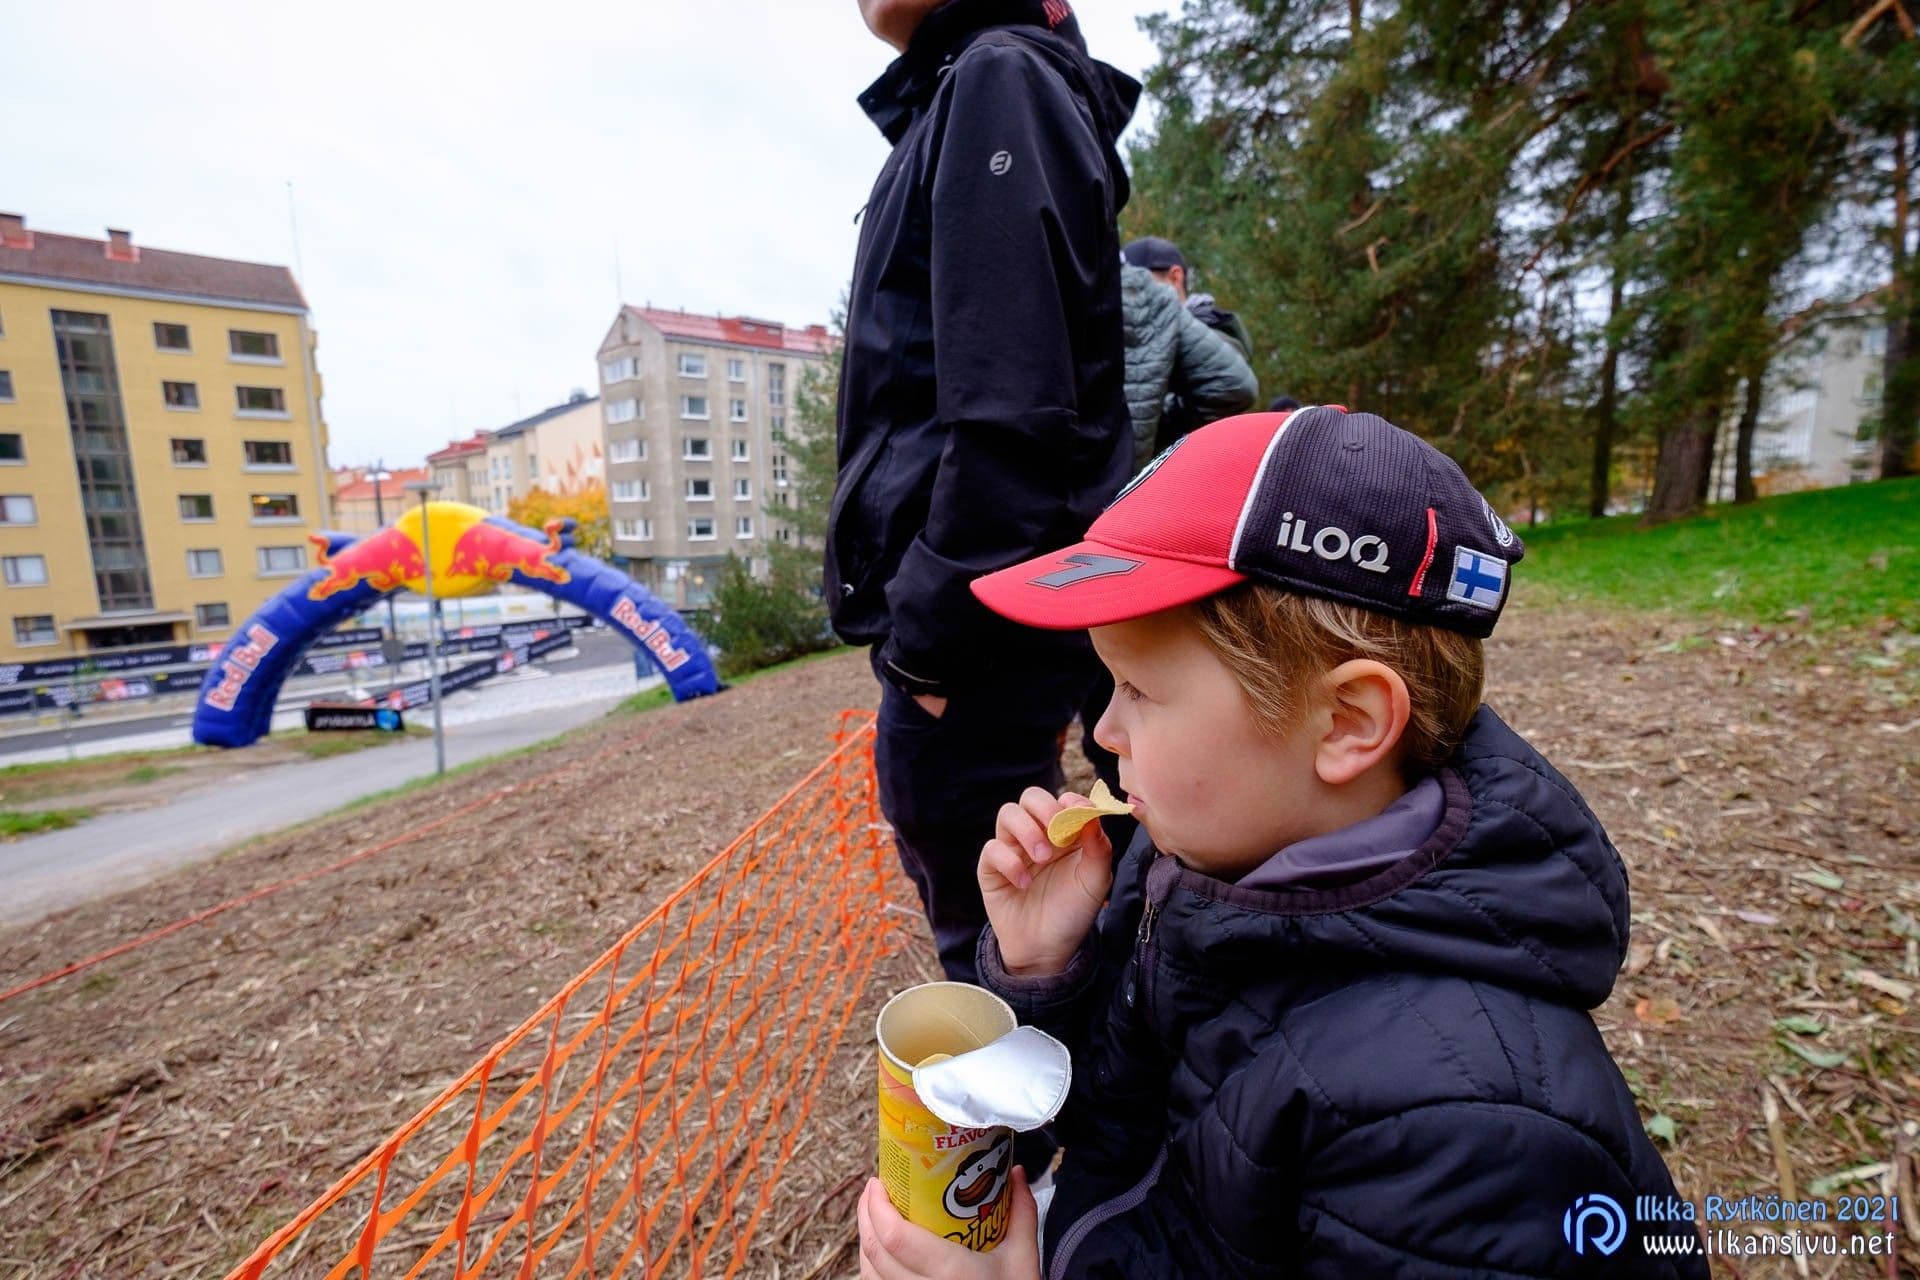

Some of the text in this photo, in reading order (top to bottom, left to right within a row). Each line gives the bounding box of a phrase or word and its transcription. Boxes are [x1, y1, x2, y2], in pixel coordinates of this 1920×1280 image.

[1026, 553, 1145, 591] 7
[1277, 512, 1391, 574] iLOQ
[205, 661, 251, 711] Red
[230, 624, 279, 670] Bull
[611, 597, 691, 672] Red Bull
